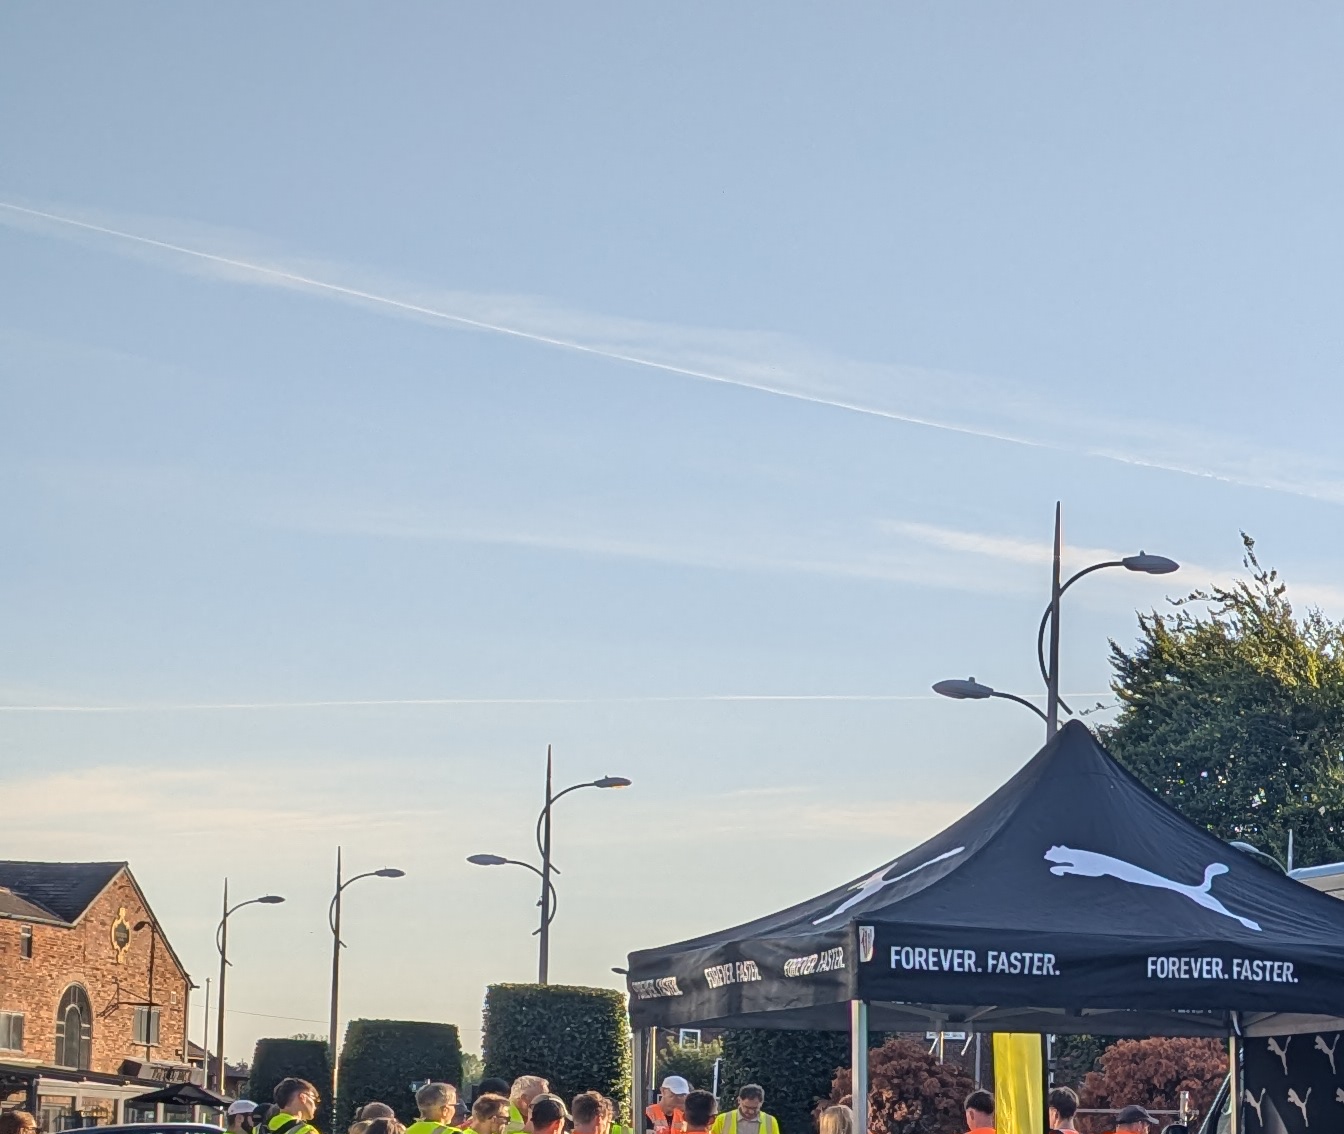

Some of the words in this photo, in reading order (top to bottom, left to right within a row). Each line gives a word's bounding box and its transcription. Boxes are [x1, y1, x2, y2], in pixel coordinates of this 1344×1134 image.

[890, 946, 982, 972] FOREVER.
[987, 951, 1060, 976] FASTER.
[1147, 956, 1229, 980] FOREVER.
[1232, 958, 1299, 983] FASTER.
